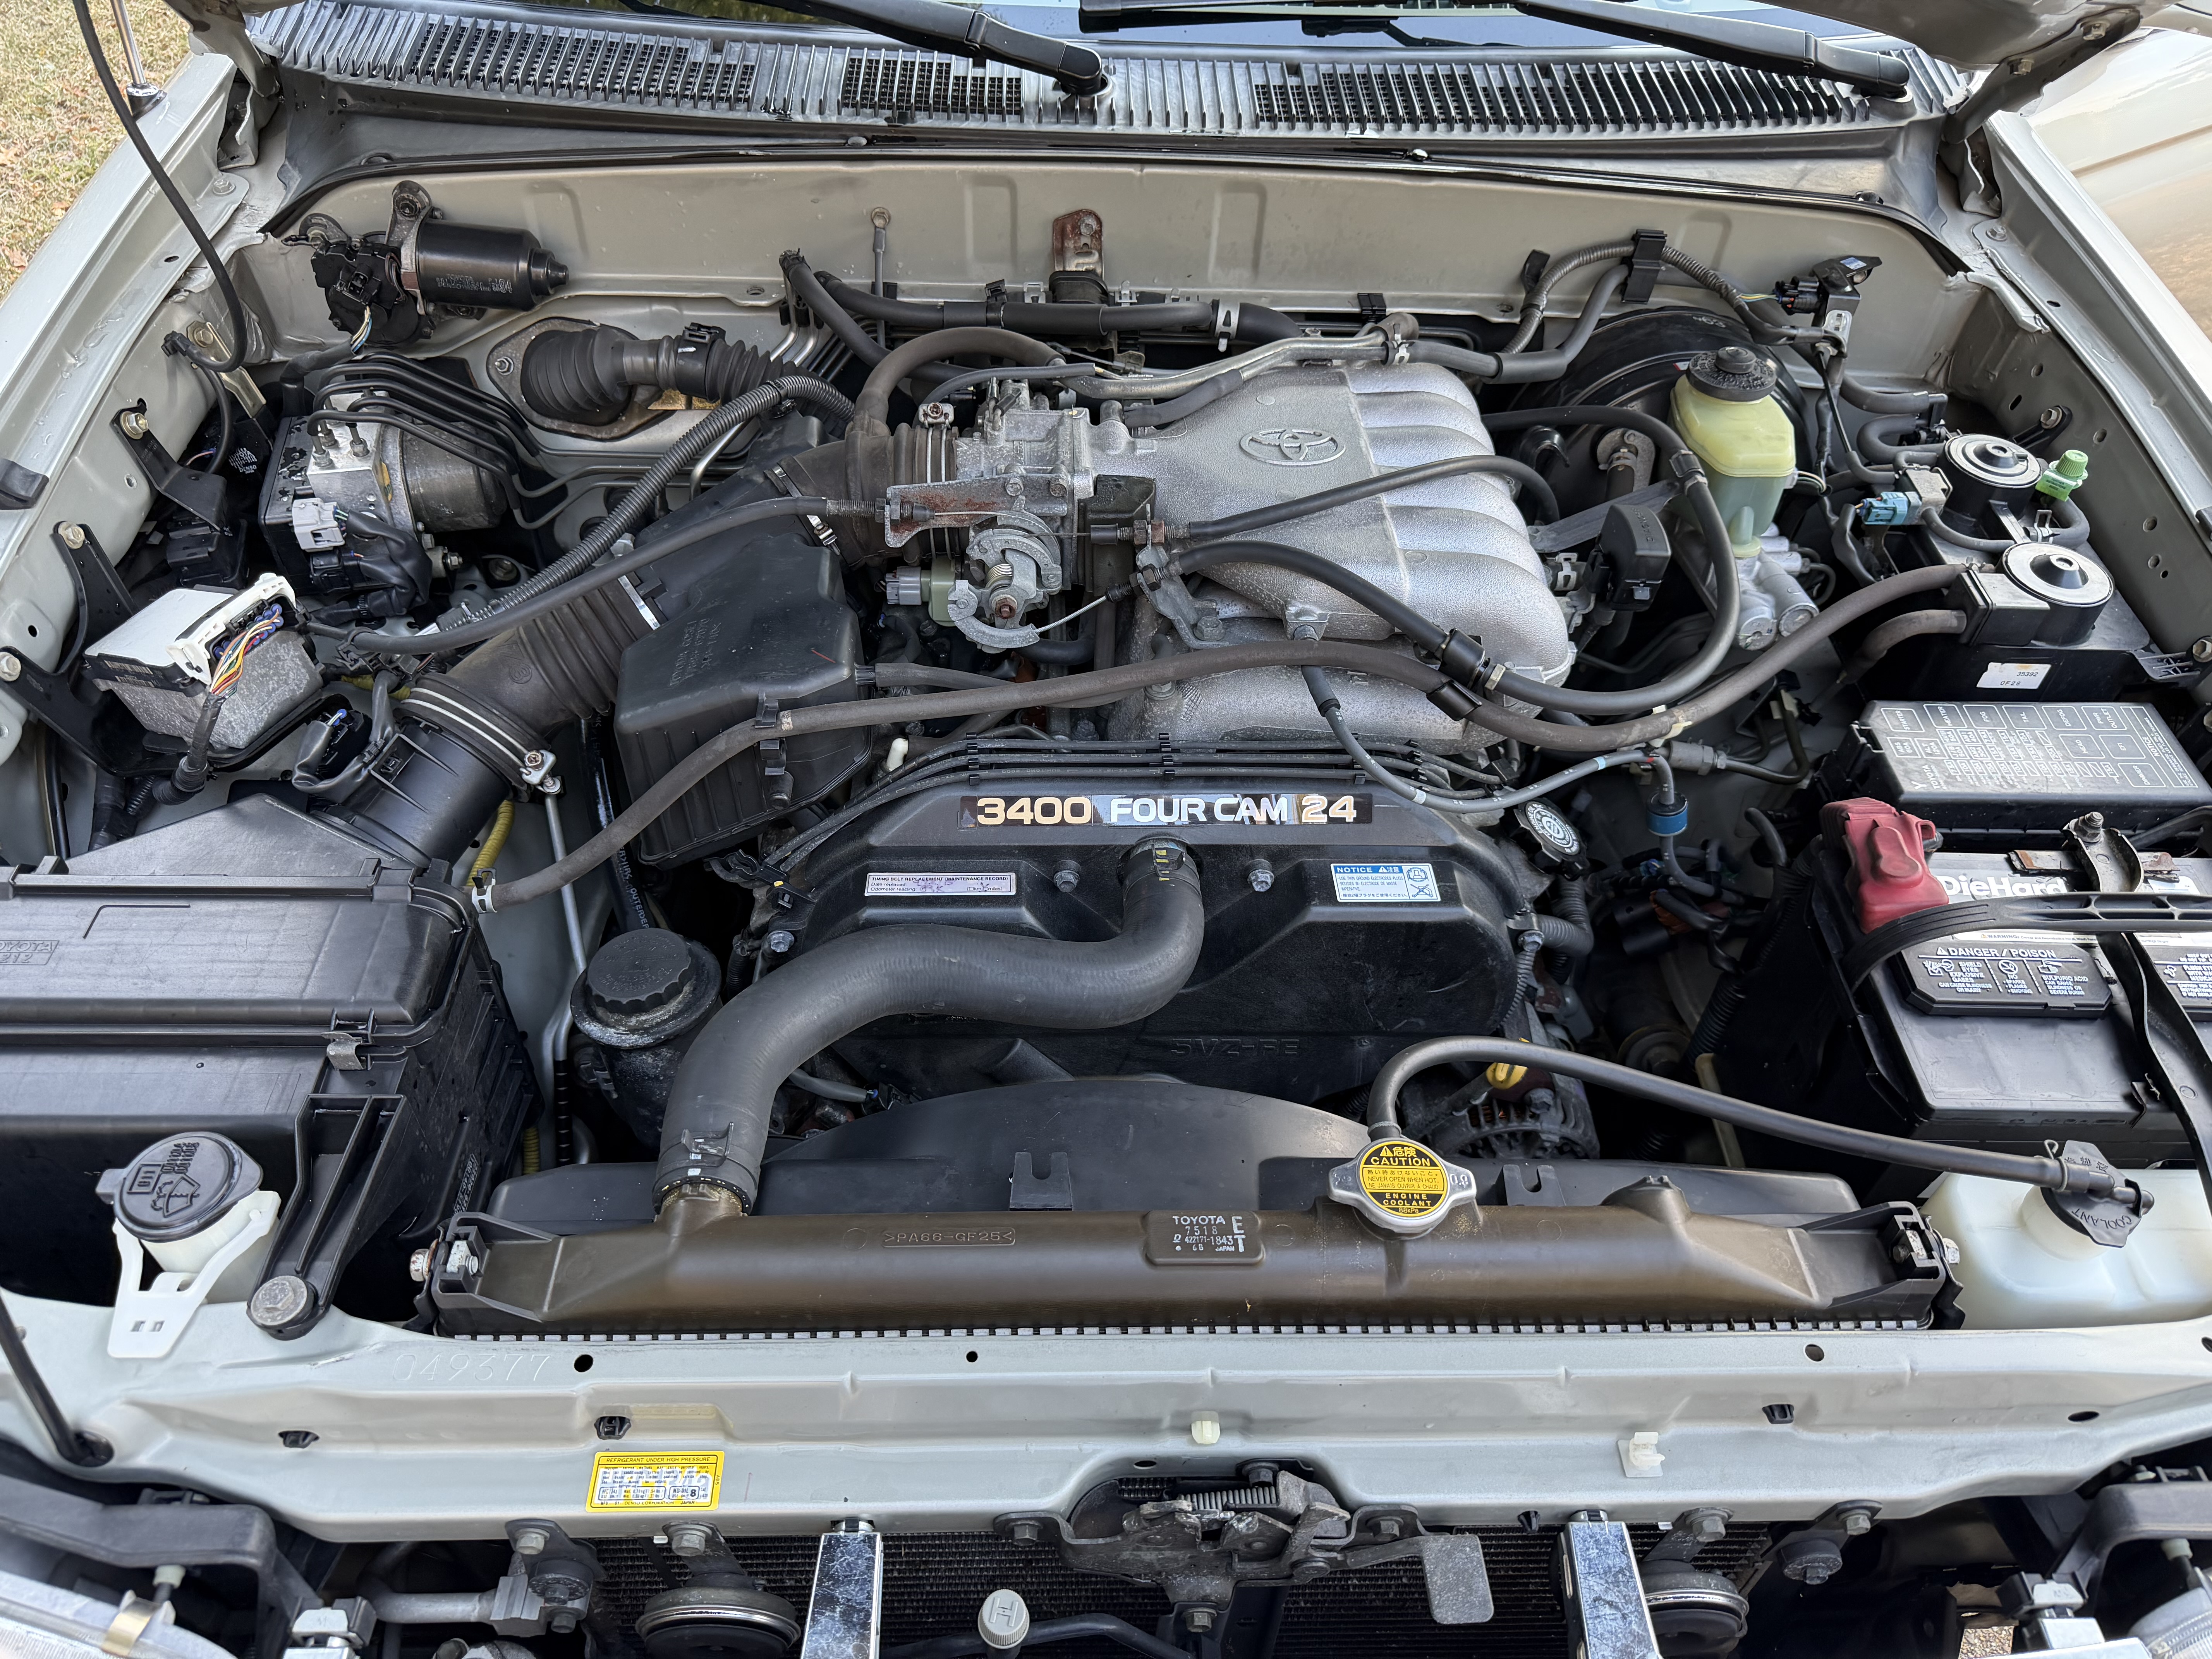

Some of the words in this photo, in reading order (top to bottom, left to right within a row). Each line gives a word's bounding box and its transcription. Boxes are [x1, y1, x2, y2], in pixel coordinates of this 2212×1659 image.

[1895, 711, 1910, 730] STARTER
[1937, 706, 1953, 726] HEATER
[1979, 711, 1990, 721] FOG
[2018, 712, 2030, 722] TAIL
[2057, 709, 2071, 726] DEFOG
[2092, 712, 2104, 723] PWR
[2101, 708, 2117, 728] OUTLET
[1895, 742, 1905, 753] ABS
[1902, 742, 1913, 752] 60A
[1921, 744, 1932, 753] ALT
[1928, 742, 1941, 754] 120A
[2075, 739, 2088, 753] HEAD
[2116, 742, 2127, 750] EFI
[2142, 736, 2160, 757] NOTICE
[1922, 764, 1941, 789] TOYOTA
[2133, 765, 2150, 785] DIMMER
[977, 797, 1092, 824] 3400
[1111, 797, 1205, 823] FOUR
[1214, 797, 1288, 823] CAM
[1301, 795, 1357, 823] 24
[1936, 875, 2068, 897] DieHard
[1948, 947, 1999, 957] DANGER
[2009, 949, 2057, 958] POISON
[1393, 1147, 1417, 1157] 危険
[1371, 1157, 1431, 1166] CAUTION
[1172, 1216, 1226, 1225] TOYOTA
[1232, 1216, 1244, 1233] E
[2071, 1208, 2131, 1229] COOLANT
[884, 1233, 1012, 1242] >PA66-GF25<
[1185, 1235, 1234, 1245] 422171-1843
[1234, 1235, 1246, 1252] T
[392, 1353, 552, 1381] 049377
[990, 1597, 1019, 1627] H
